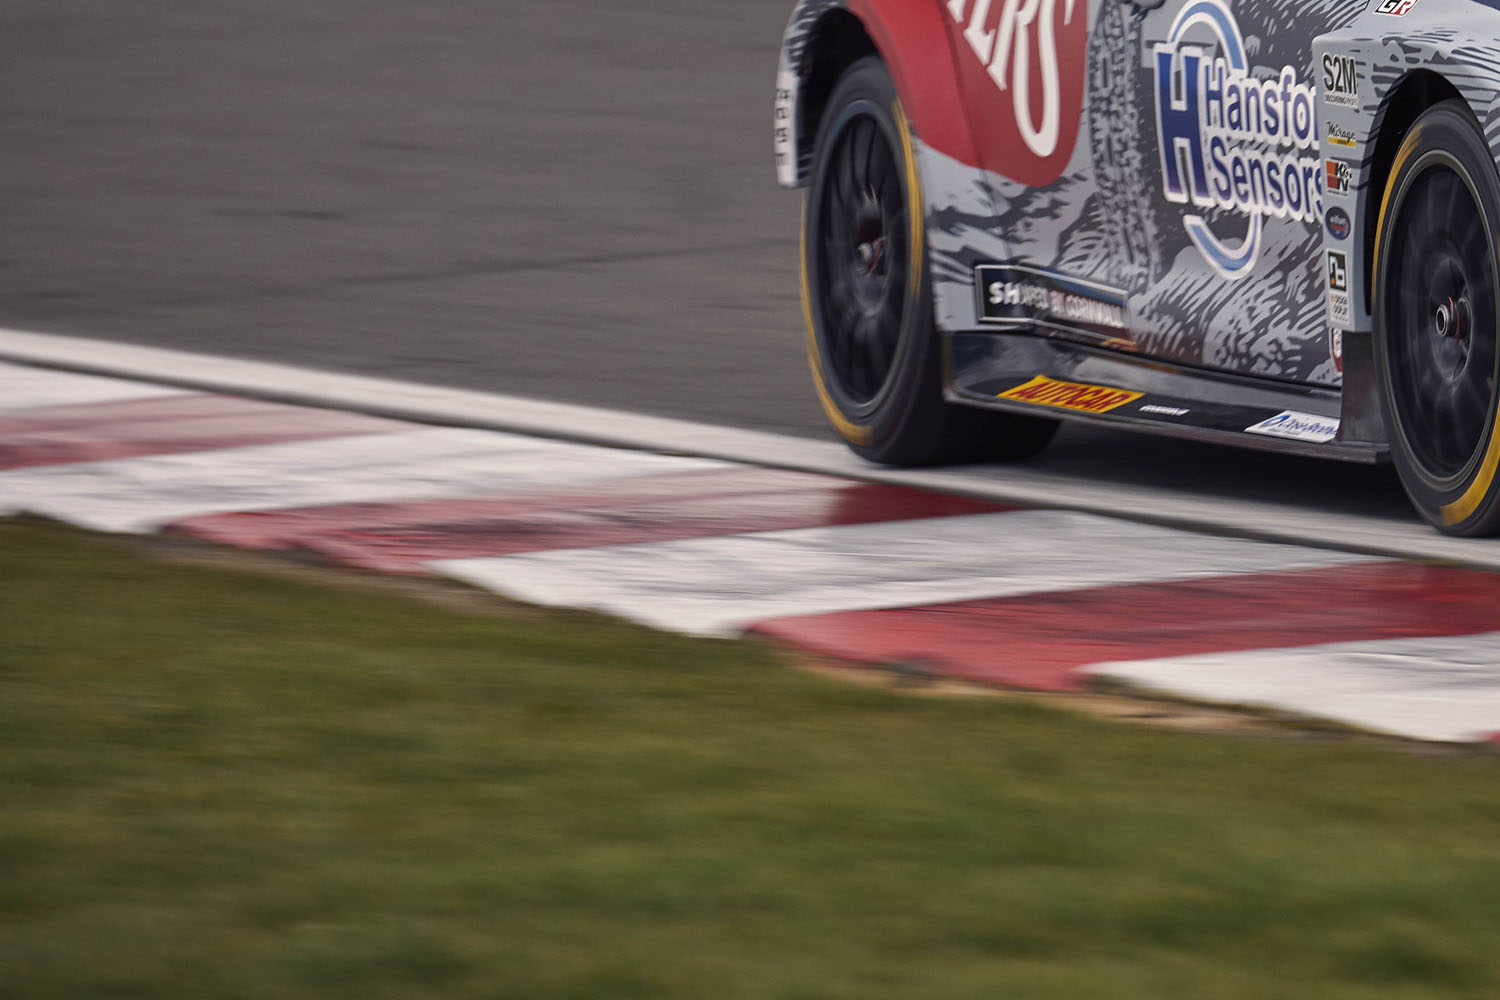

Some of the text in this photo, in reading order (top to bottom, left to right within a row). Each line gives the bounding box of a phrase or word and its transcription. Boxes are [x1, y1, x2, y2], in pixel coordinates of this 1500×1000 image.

[1323, 54, 1357, 95] S2M
[1203, 64, 1319, 143] Hansfo
[1008, 381, 1131, 411] AUTOCAR
